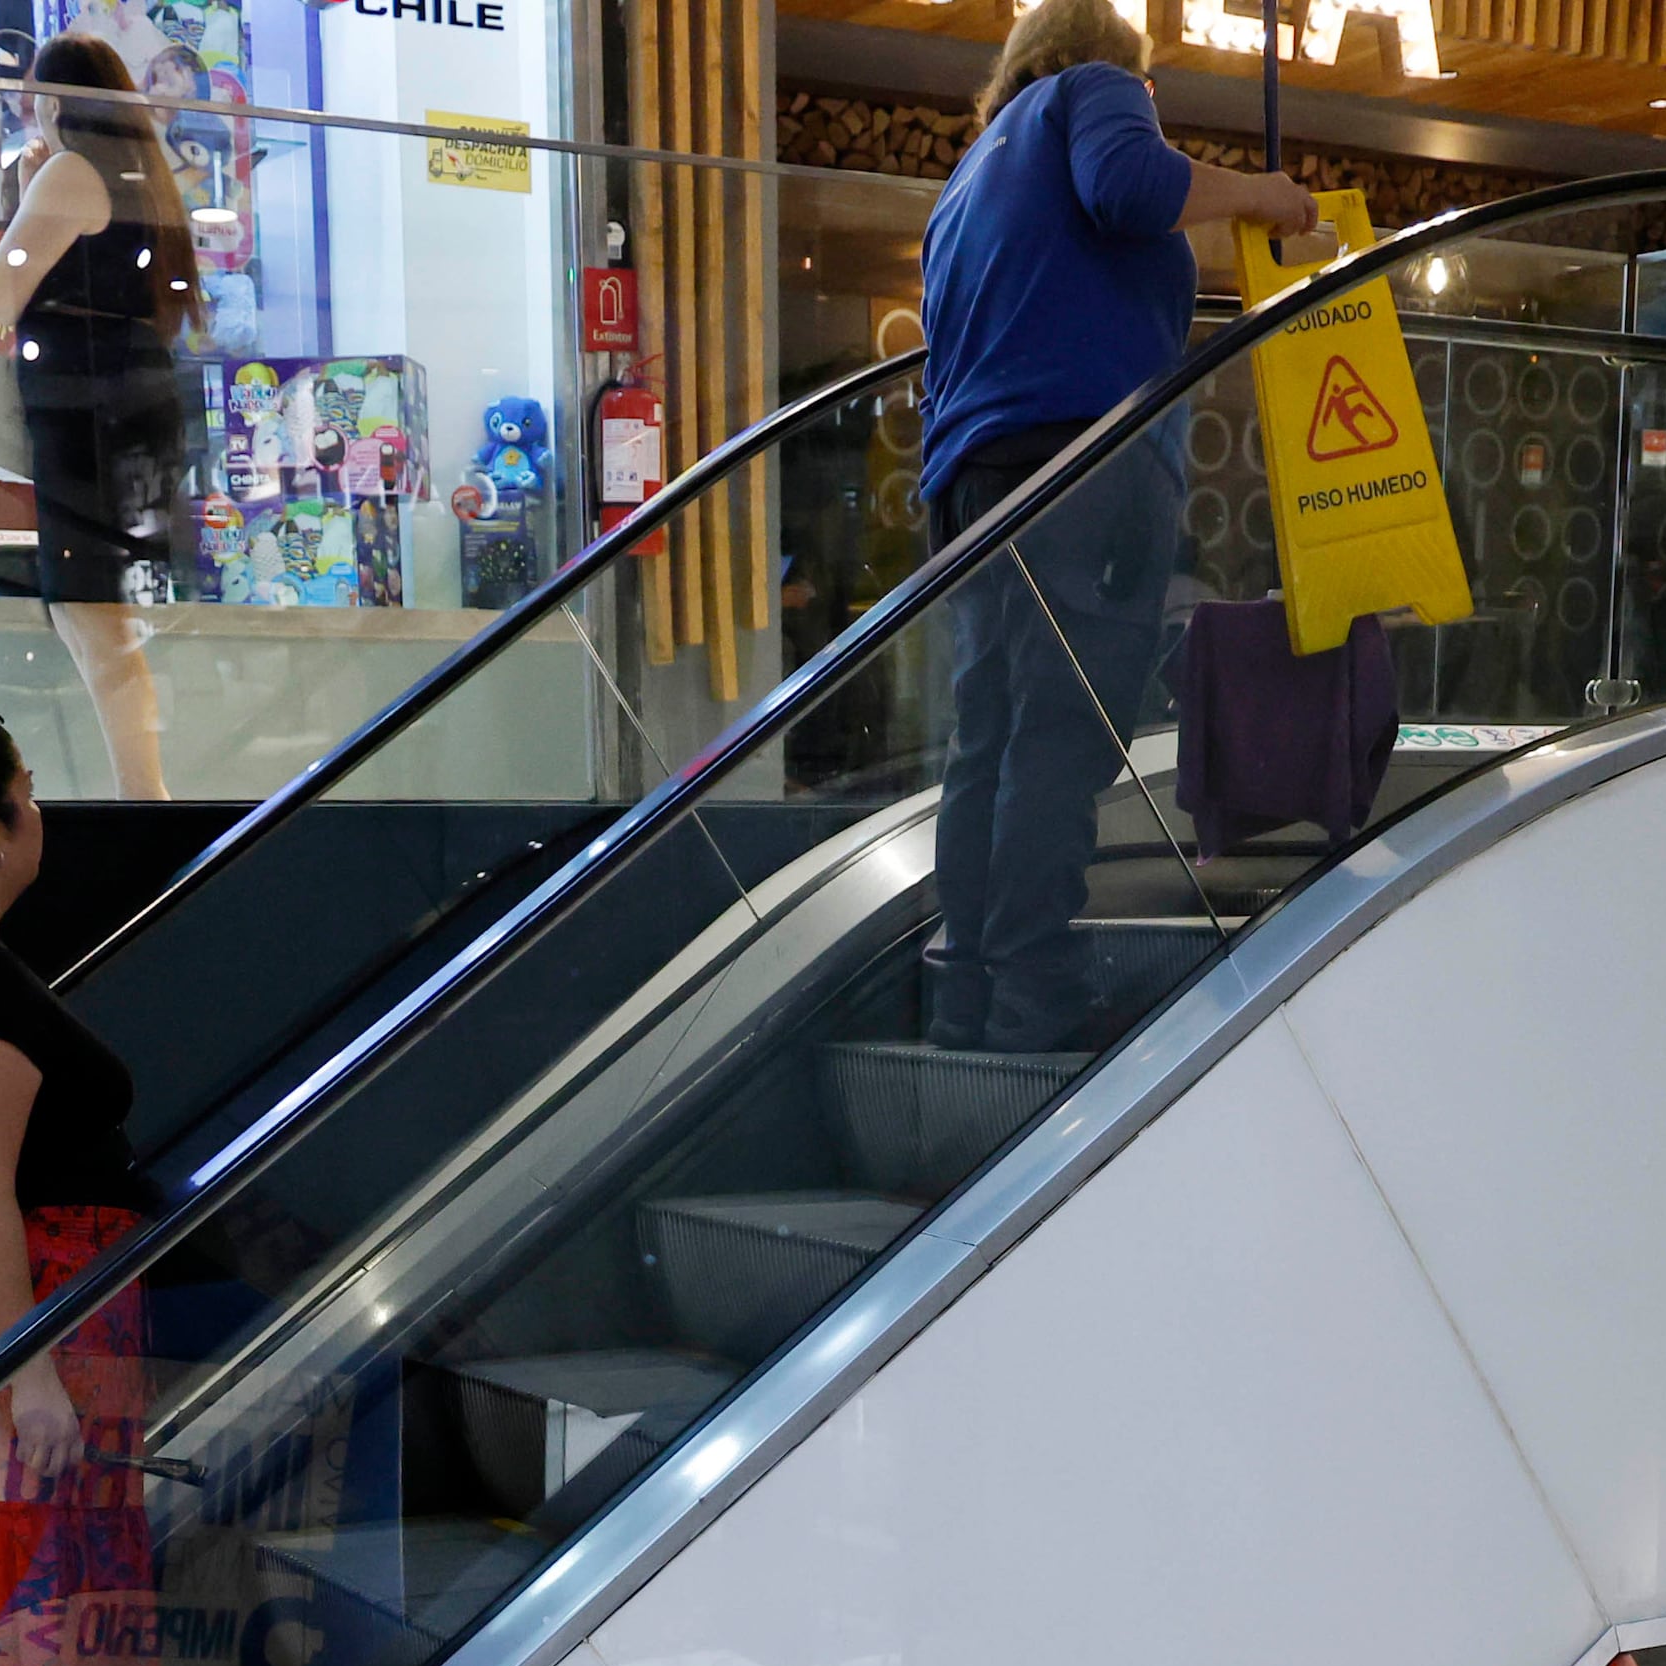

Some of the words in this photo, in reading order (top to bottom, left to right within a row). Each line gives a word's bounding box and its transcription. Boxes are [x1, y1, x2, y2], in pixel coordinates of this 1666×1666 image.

[355, 0, 505, 31] CHILE
[465, 153, 528, 172] DOMICILIO
[593, 329, 632, 342] Extintor
[1298, 489, 1343, 514] PISO
[1347, 470, 1427, 505] HUMEDO
